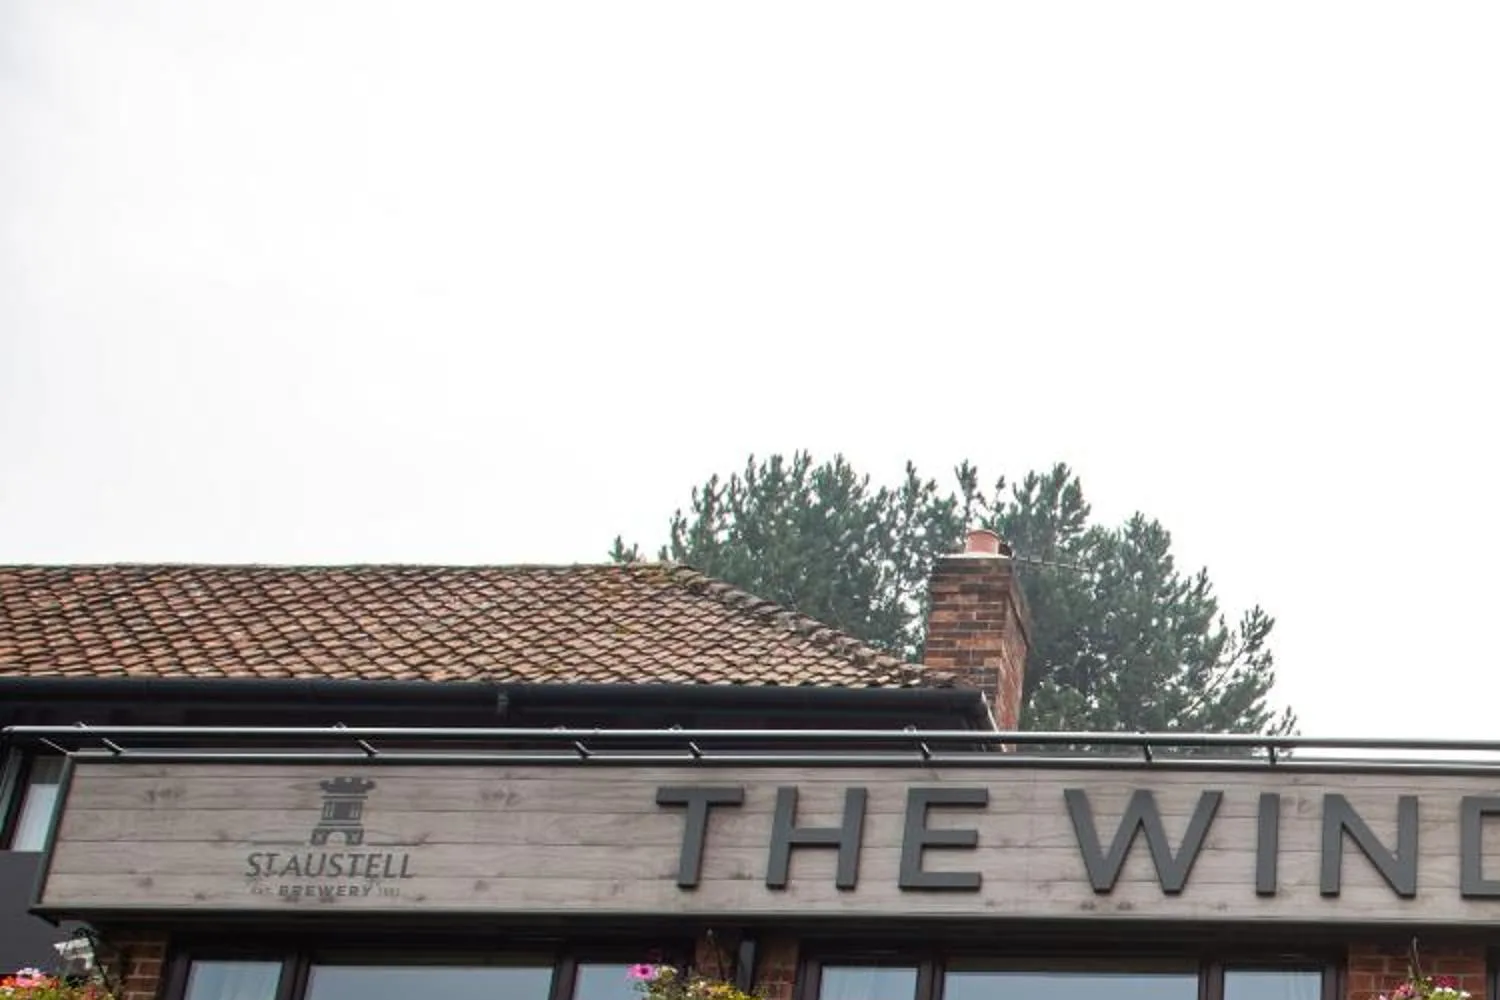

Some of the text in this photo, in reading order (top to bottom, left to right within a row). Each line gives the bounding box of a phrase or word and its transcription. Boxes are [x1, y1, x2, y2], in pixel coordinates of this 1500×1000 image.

[655, 786, 989, 892] THE
[279, 852, 417, 880] AUSTELL
[279, 885, 371, 898] BREWERY
